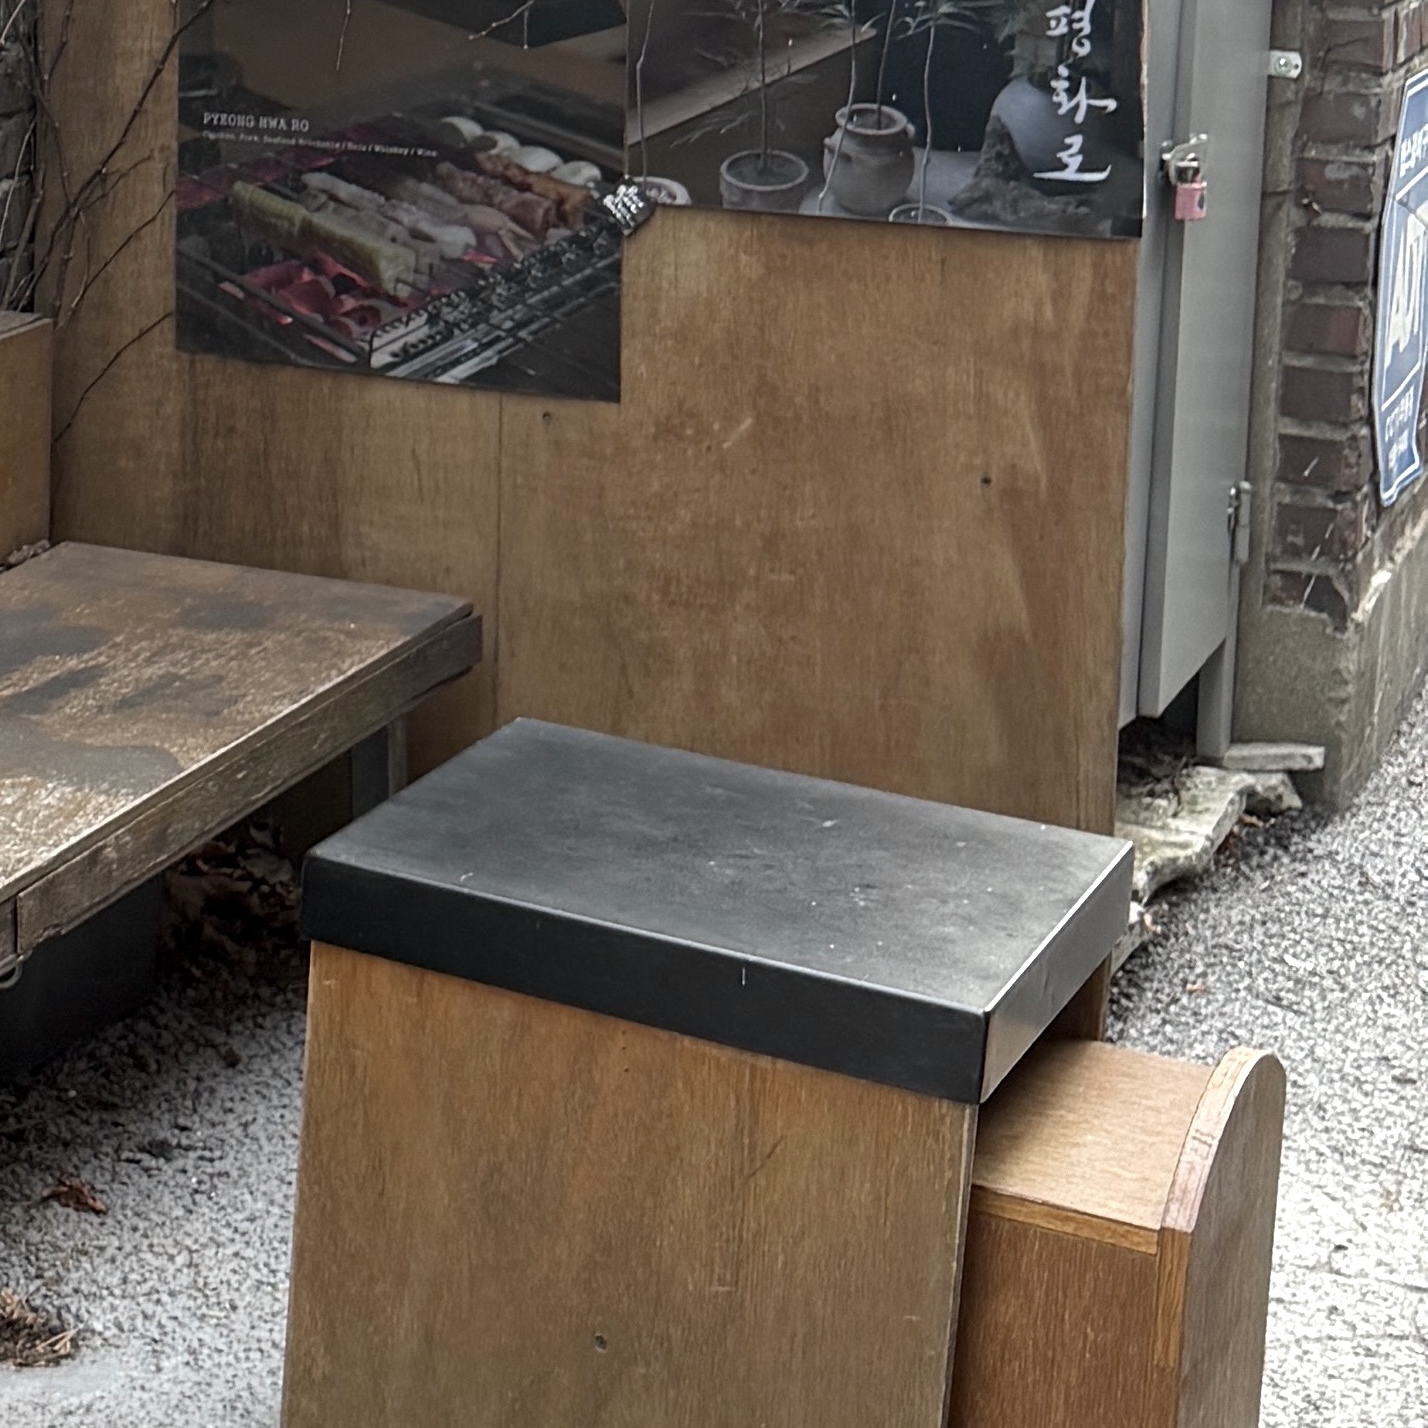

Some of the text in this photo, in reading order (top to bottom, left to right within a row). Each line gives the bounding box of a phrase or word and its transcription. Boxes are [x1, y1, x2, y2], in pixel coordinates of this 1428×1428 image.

[203, 112, 310, 133] PYEONG HWA RO
